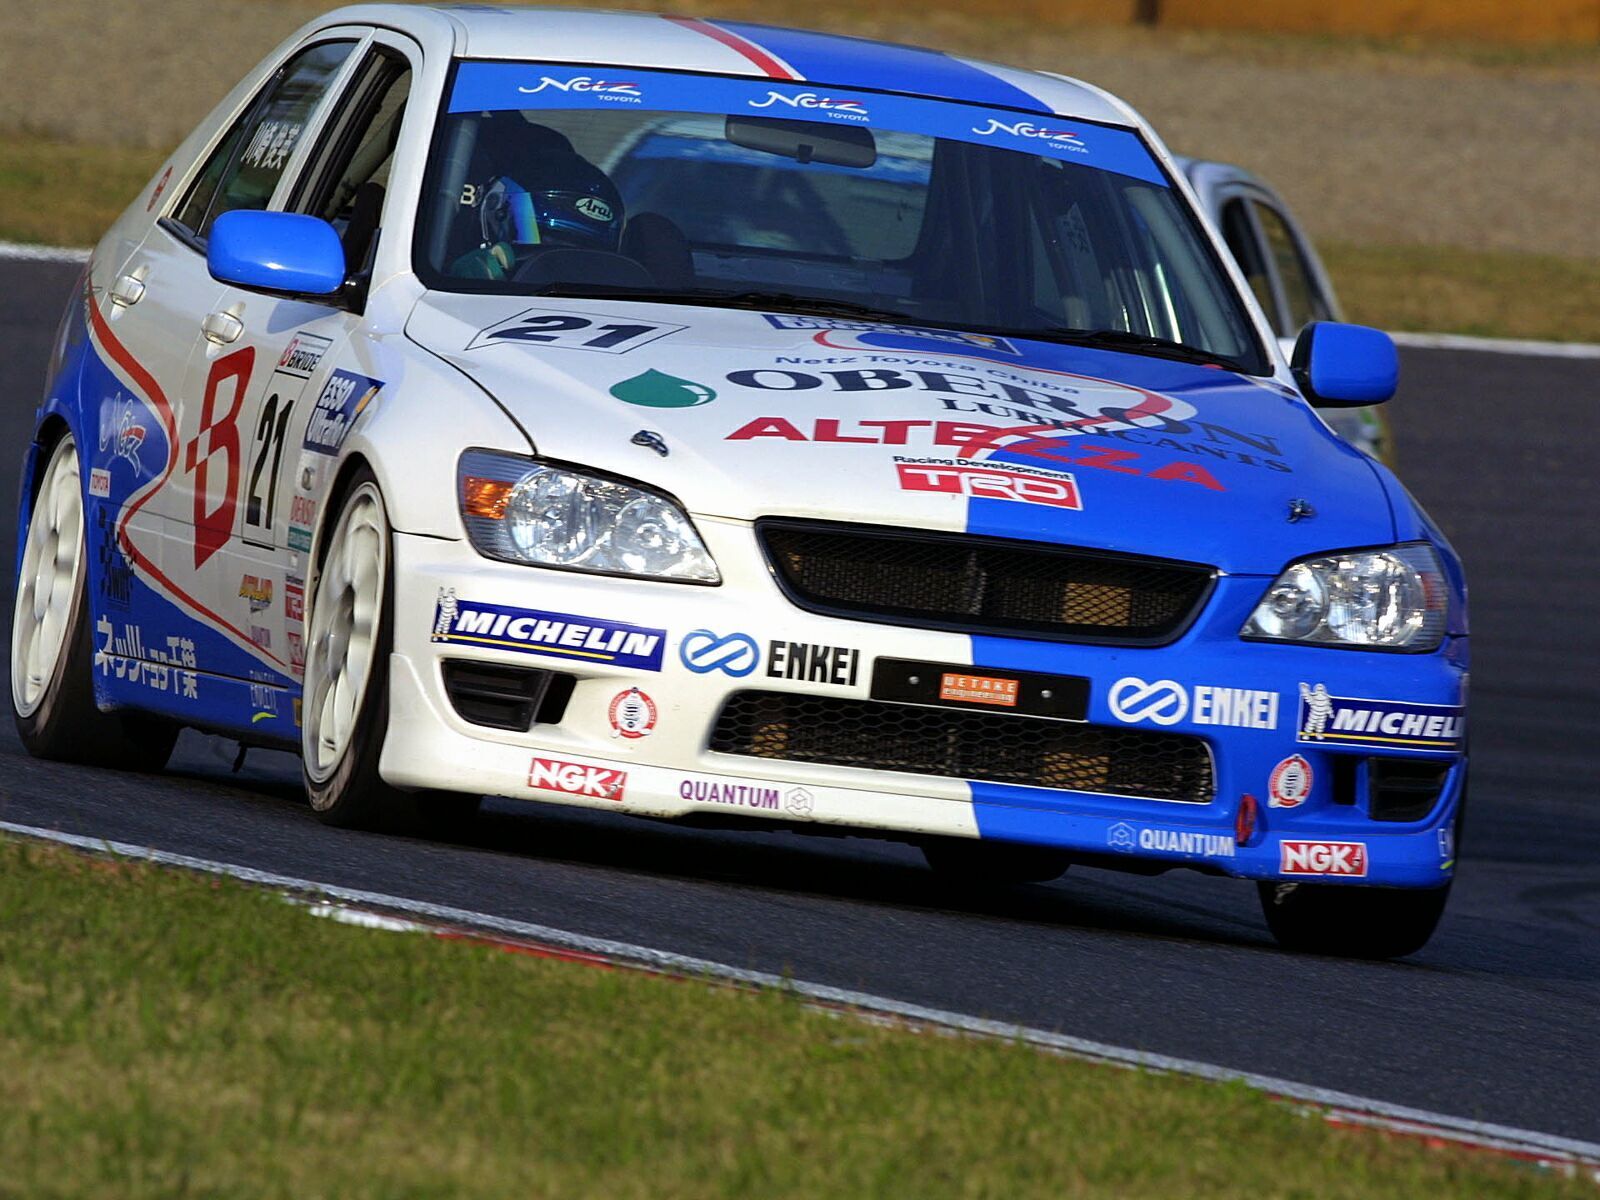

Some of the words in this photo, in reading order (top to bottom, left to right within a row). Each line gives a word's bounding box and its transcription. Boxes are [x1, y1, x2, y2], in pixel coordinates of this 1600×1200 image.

[598, 94, 642, 103] TOYOTA
[827, 111, 870, 122] TOYOTA
[1047, 142, 1089, 154] TOYOTA
[487, 315, 658, 349] 21
[287, 349, 322, 372] BRIDE
[775, 356, 858, 365] Netz
[864, 355, 976, 372] Toyota
[986, 368, 1080, 395] Chiba
[317, 376, 356, 411] ESSO
[725, 369, 1283, 456] OBERON
[936, 398, 1293, 473] LUBRICANTS
[246, 393, 295, 530] 21
[723, 416, 1227, 492] ALTEZZA
[893, 455, 953, 466] Racing
[956, 457, 1072, 480] Development
[904, 467, 1069, 501] TRD
[455, 609, 660, 657] MICHELIN
[767, 640, 860, 687] ENKEI
[1192, 685, 1280, 730] ENKEI
[530, 758, 615, 797] NGK
[679, 779, 779, 810] QUANTUM
[1139, 829, 1235, 857] QUANTUM
[1283, 843, 1354, 874] NGK
